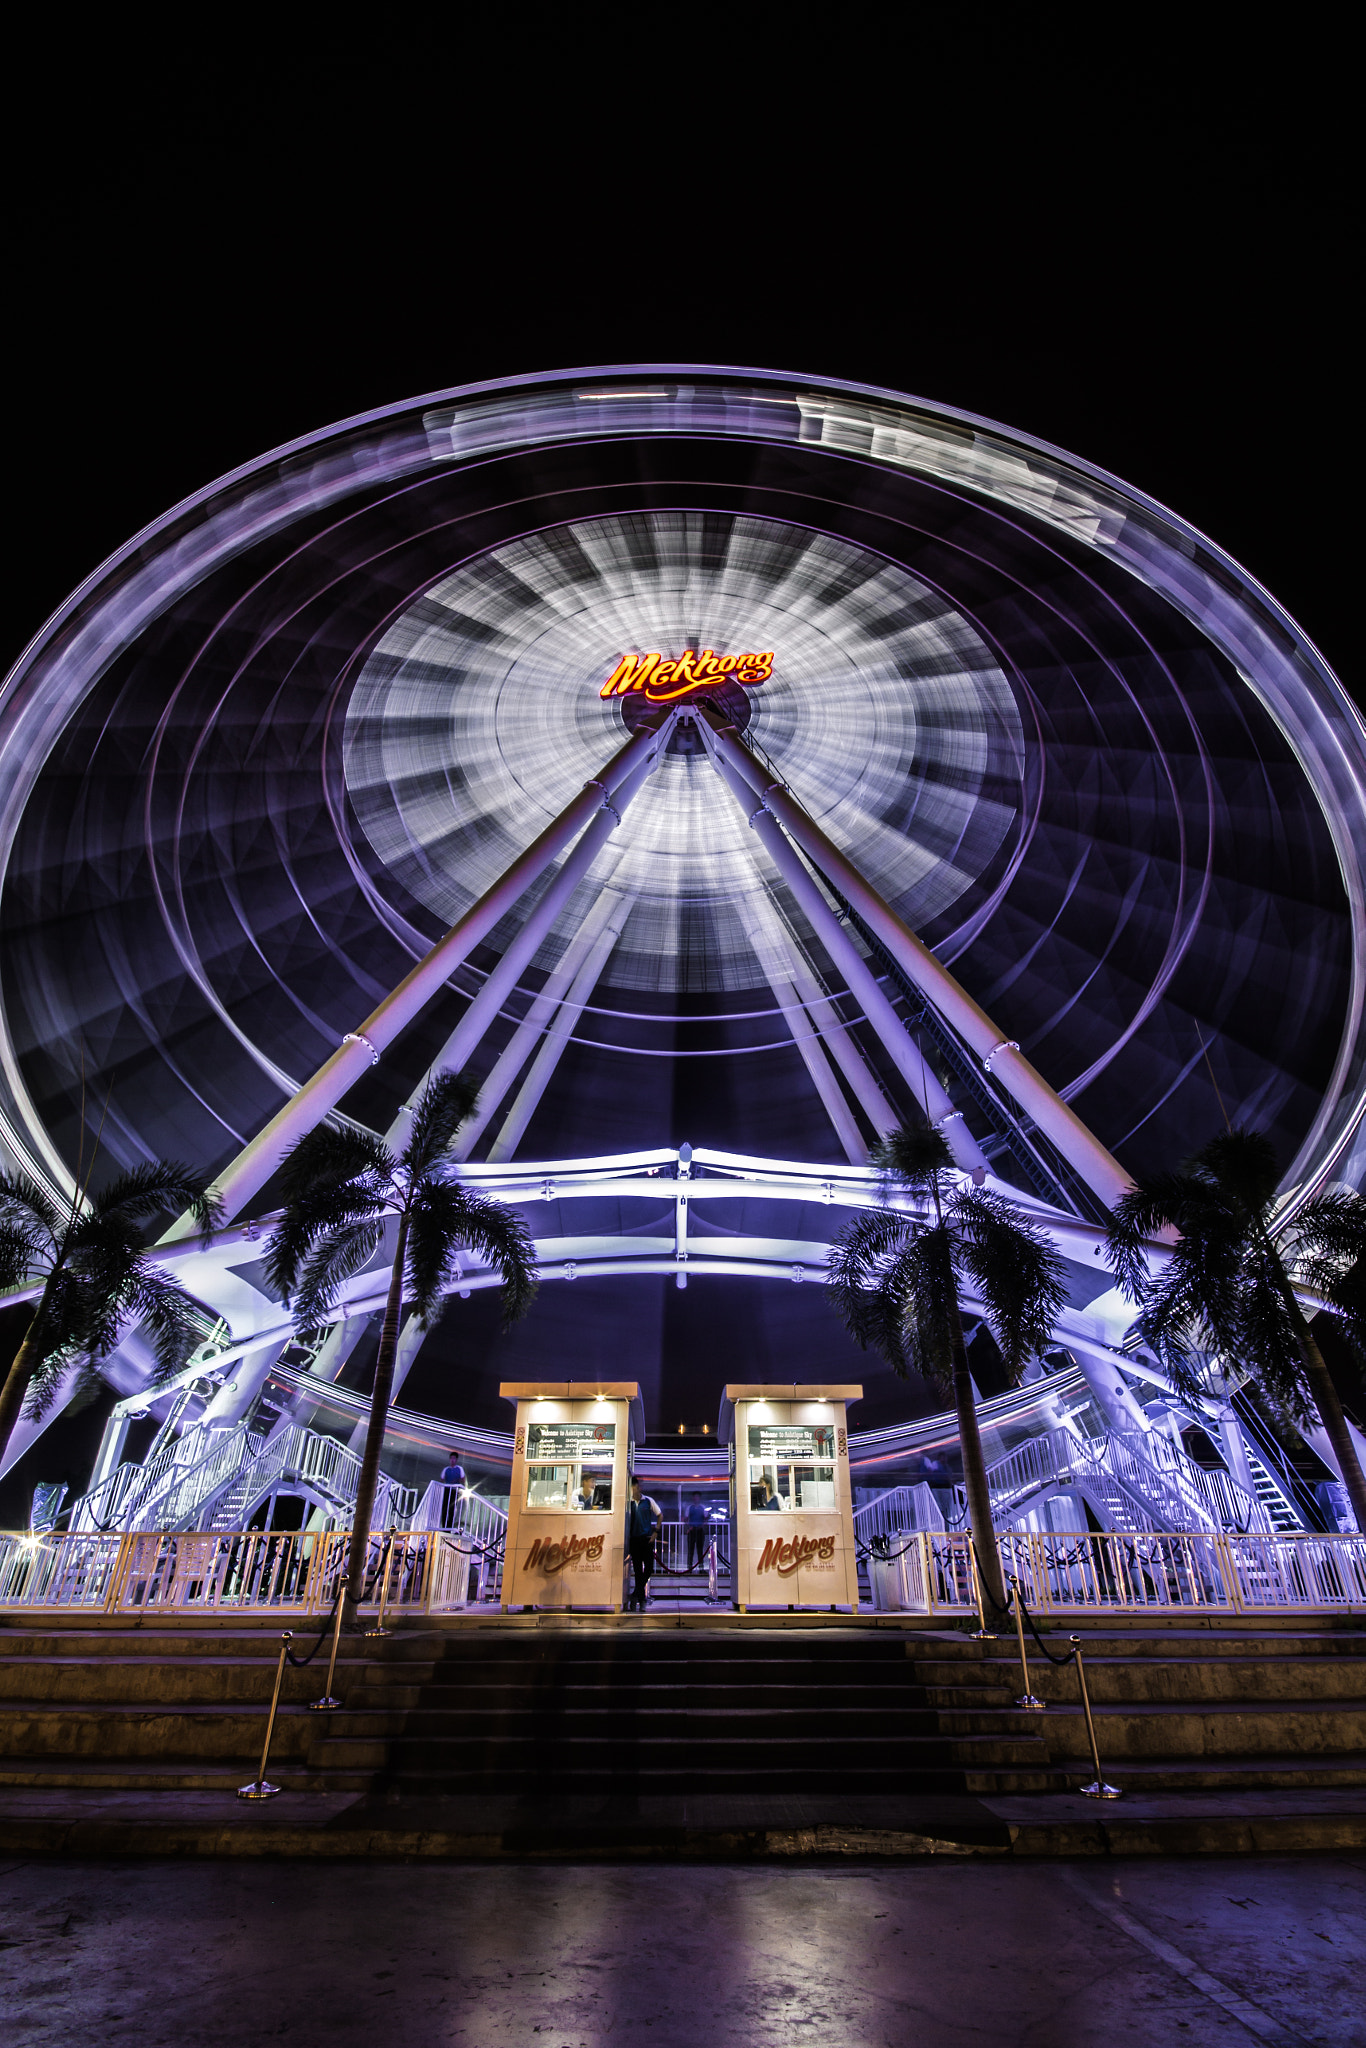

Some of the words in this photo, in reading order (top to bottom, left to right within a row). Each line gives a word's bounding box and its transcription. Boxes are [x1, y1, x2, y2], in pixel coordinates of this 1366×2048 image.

[600, 650, 774, 702] Mekhong
[585, 1429, 593, 1437] Sky
[523, 1534, 605, 1573] Mekhong
[757, 1535, 835, 1573] Mekhong
